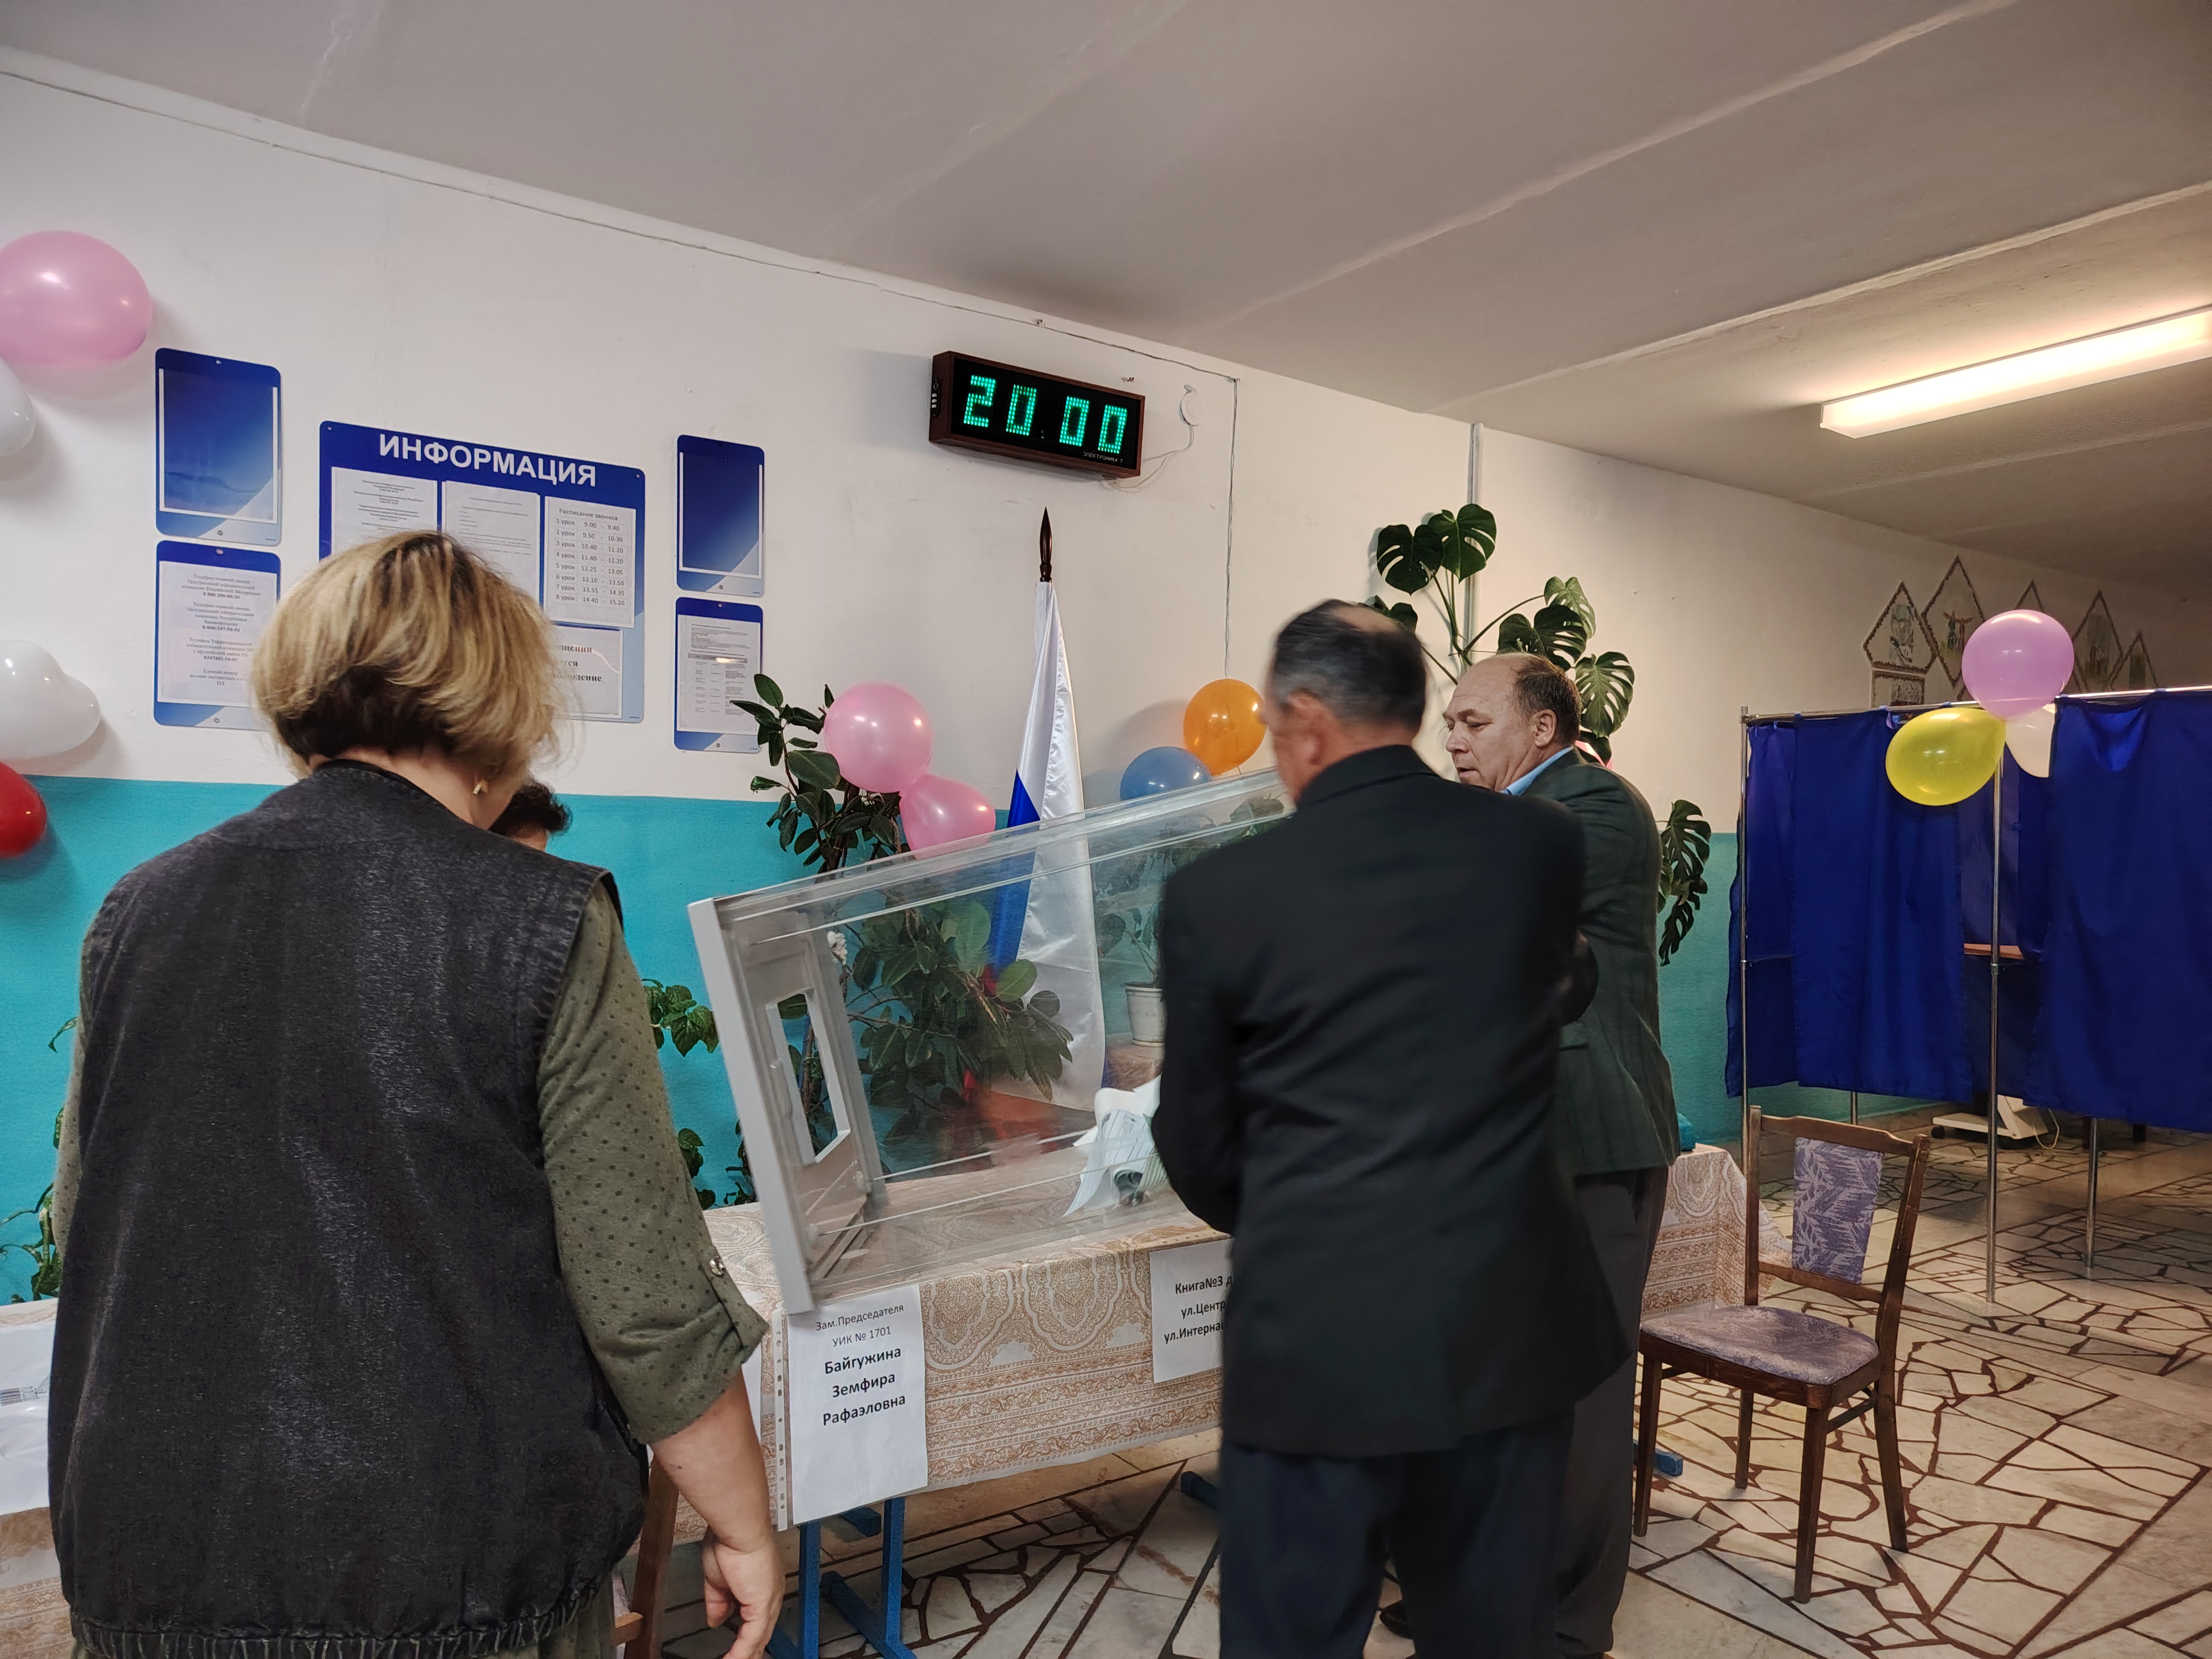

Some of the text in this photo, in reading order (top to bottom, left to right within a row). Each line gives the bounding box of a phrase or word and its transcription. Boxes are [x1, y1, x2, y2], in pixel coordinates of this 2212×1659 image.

[379, 433, 596, 487] ИНФОРМАЦИЯ
[1083, 451, 1118, 462] ЭЛЕКТРОНИКА
[559, 508, 593, 518] Расписание
[557, 644, 592, 653] щении
[1175, 1276, 1223, 1295] Книга№3
[816, 1305, 904, 1331] Зам.Председателя
[1181, 1301, 1225, 1319] ул.Центр
[832, 1326, 891, 1347] УИК № 1701
[825, 1348, 901, 1374] Байгужина
[832, 1374, 895, 1398] Земфира
[823, 1395, 905, 1426] Рафаэловна
